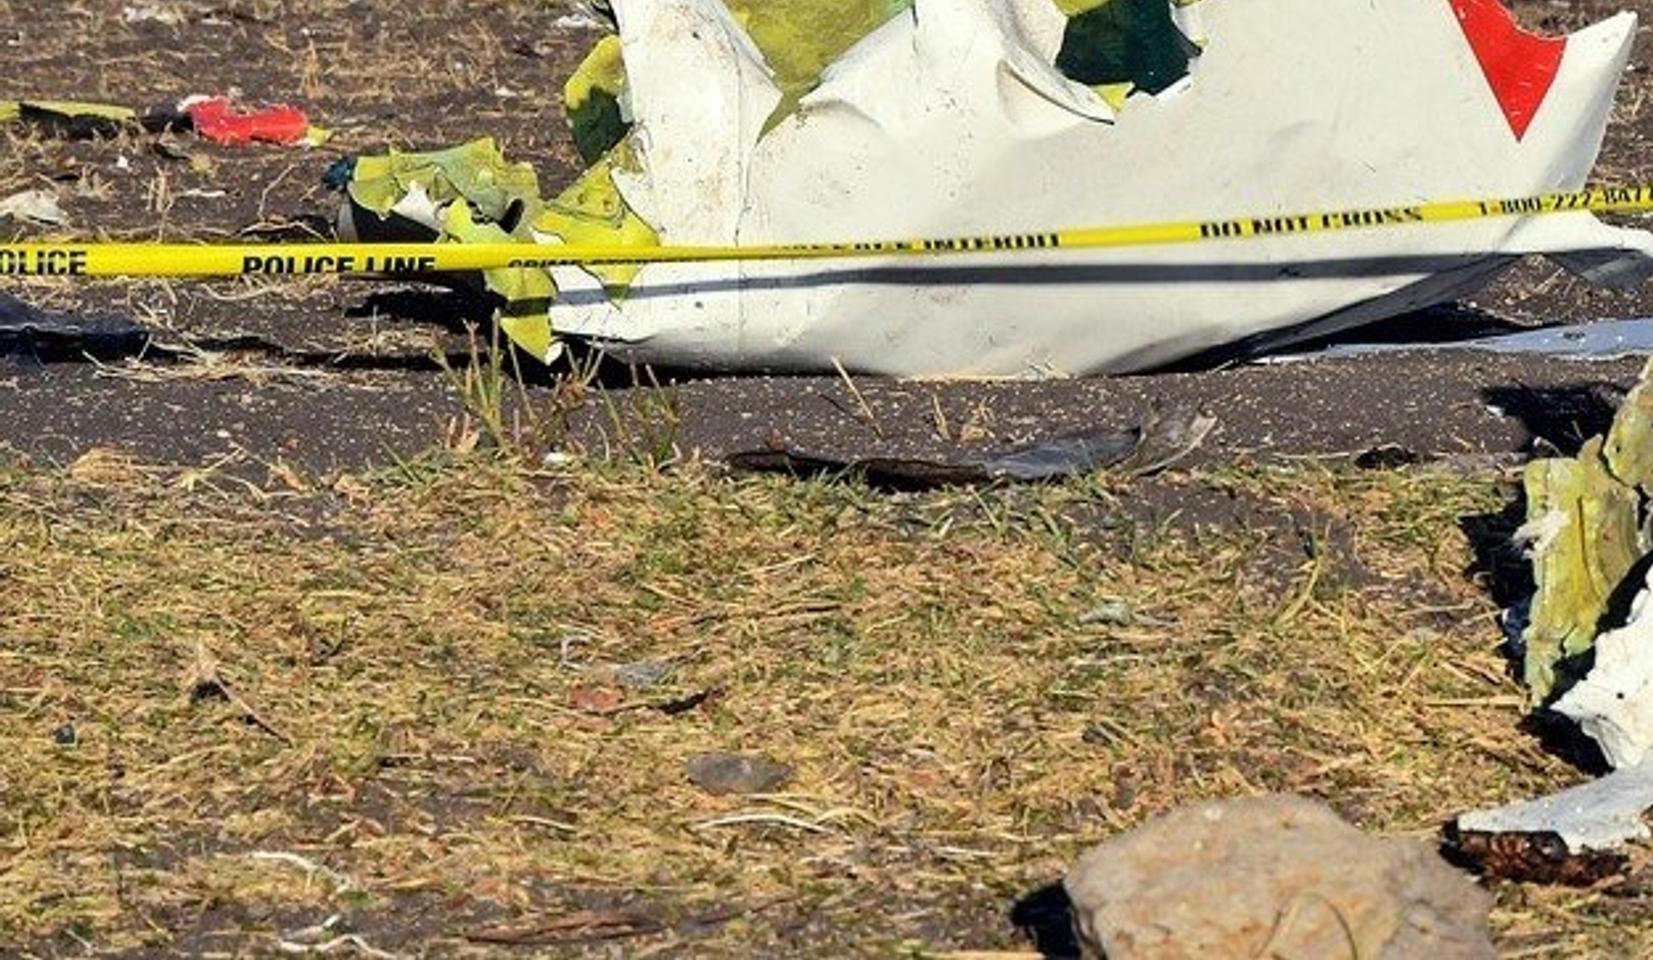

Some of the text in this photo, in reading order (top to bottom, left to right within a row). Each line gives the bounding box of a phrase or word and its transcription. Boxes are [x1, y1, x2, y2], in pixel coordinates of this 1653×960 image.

[1251, 215, 1309, 234] NOT
[1321, 206, 1423, 229] CROSS
[242, 256, 436, 274] POLICE LINE
